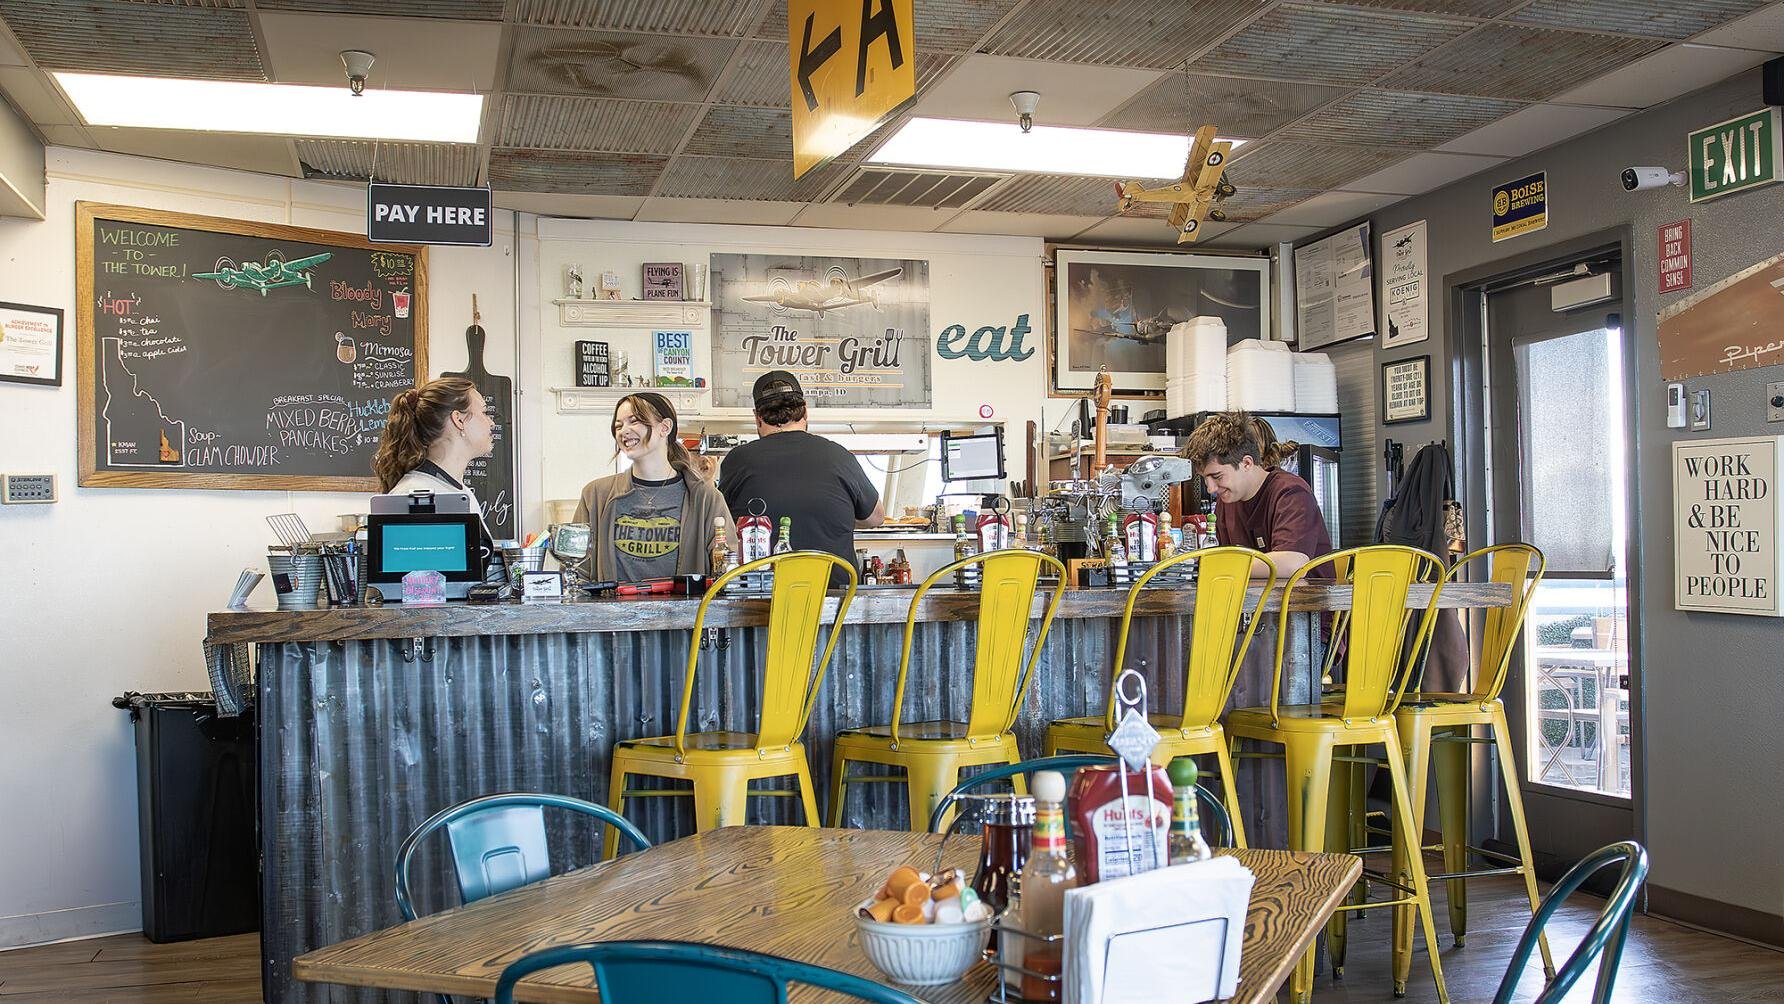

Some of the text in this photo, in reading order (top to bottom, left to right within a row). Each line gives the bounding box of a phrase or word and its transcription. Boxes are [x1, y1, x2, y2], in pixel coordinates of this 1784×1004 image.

[1703, 121, 1763, 190] EXIT
[1510, 181, 1544, 202] BOISE
[1511, 193, 1545, 211] BREWING
[375, 203, 485, 226] PAY HERE
[100, 228, 181, 247] WELCOME
[1664, 225, 1683, 243] BRING
[123, 249, 144, 261] TO
[1665, 241, 1682, 258] BACK
[102, 261, 187, 283] THE TOWER!
[647, 267, 679, 276] FLYING IS
[1660, 254, 1688, 274] COMMON
[1386, 269, 1424, 286] SERVING LOCAL
[1665, 270, 1684, 288] SENSE
[330, 280, 382, 310] Bloody
[647, 289, 679, 298] PLANE FUN
[1391, 283, 1418, 297] KOENIG
[139, 315, 161, 325] chai
[350, 310, 393, 336] Mary
[139, 327, 158, 336] tea
[771, 325, 798, 341] The
[937, 314, 1035, 362] eat
[140, 336, 182, 347] chocolate
[360, 340, 413, 356] Mimosa
[582, 342, 608, 356] COFFEE
[656, 332, 690, 349] BEST
[142, 349, 167, 360] apple
[663, 347, 690, 357] CANYON
[741, 328, 904, 374] Tower Grill
[374, 361, 406, 370] CLASSIC
[582, 362, 608, 375] ALCOHOL
[663, 356, 690, 365] COUNTY
[374, 371, 405, 380] SUNRISE
[374, 378, 415, 390] CRANBERRY
[582, 373, 609, 387] SUIT UP
[824, 374, 833, 382] &
[838, 374, 881, 383] burgers
[273, 394, 313, 404] BREAKFAST
[266, 408, 361, 440] MIXED BERRY
[279, 429, 349, 455] PANCAKES
[187, 445, 281, 467] CLAM CHOWDER
[1684, 454, 1751, 477] WORK
[1704, 477, 1768, 501] HARD
[1687, 503, 1741, 529] & BE
[614, 523, 633, 540] THE
[627, 541, 662, 554] GRILL
[1705, 530, 1760, 553] NICE
[1710, 553, 1741, 575] TO
[1686, 576, 1767, 599] PEOPLE
